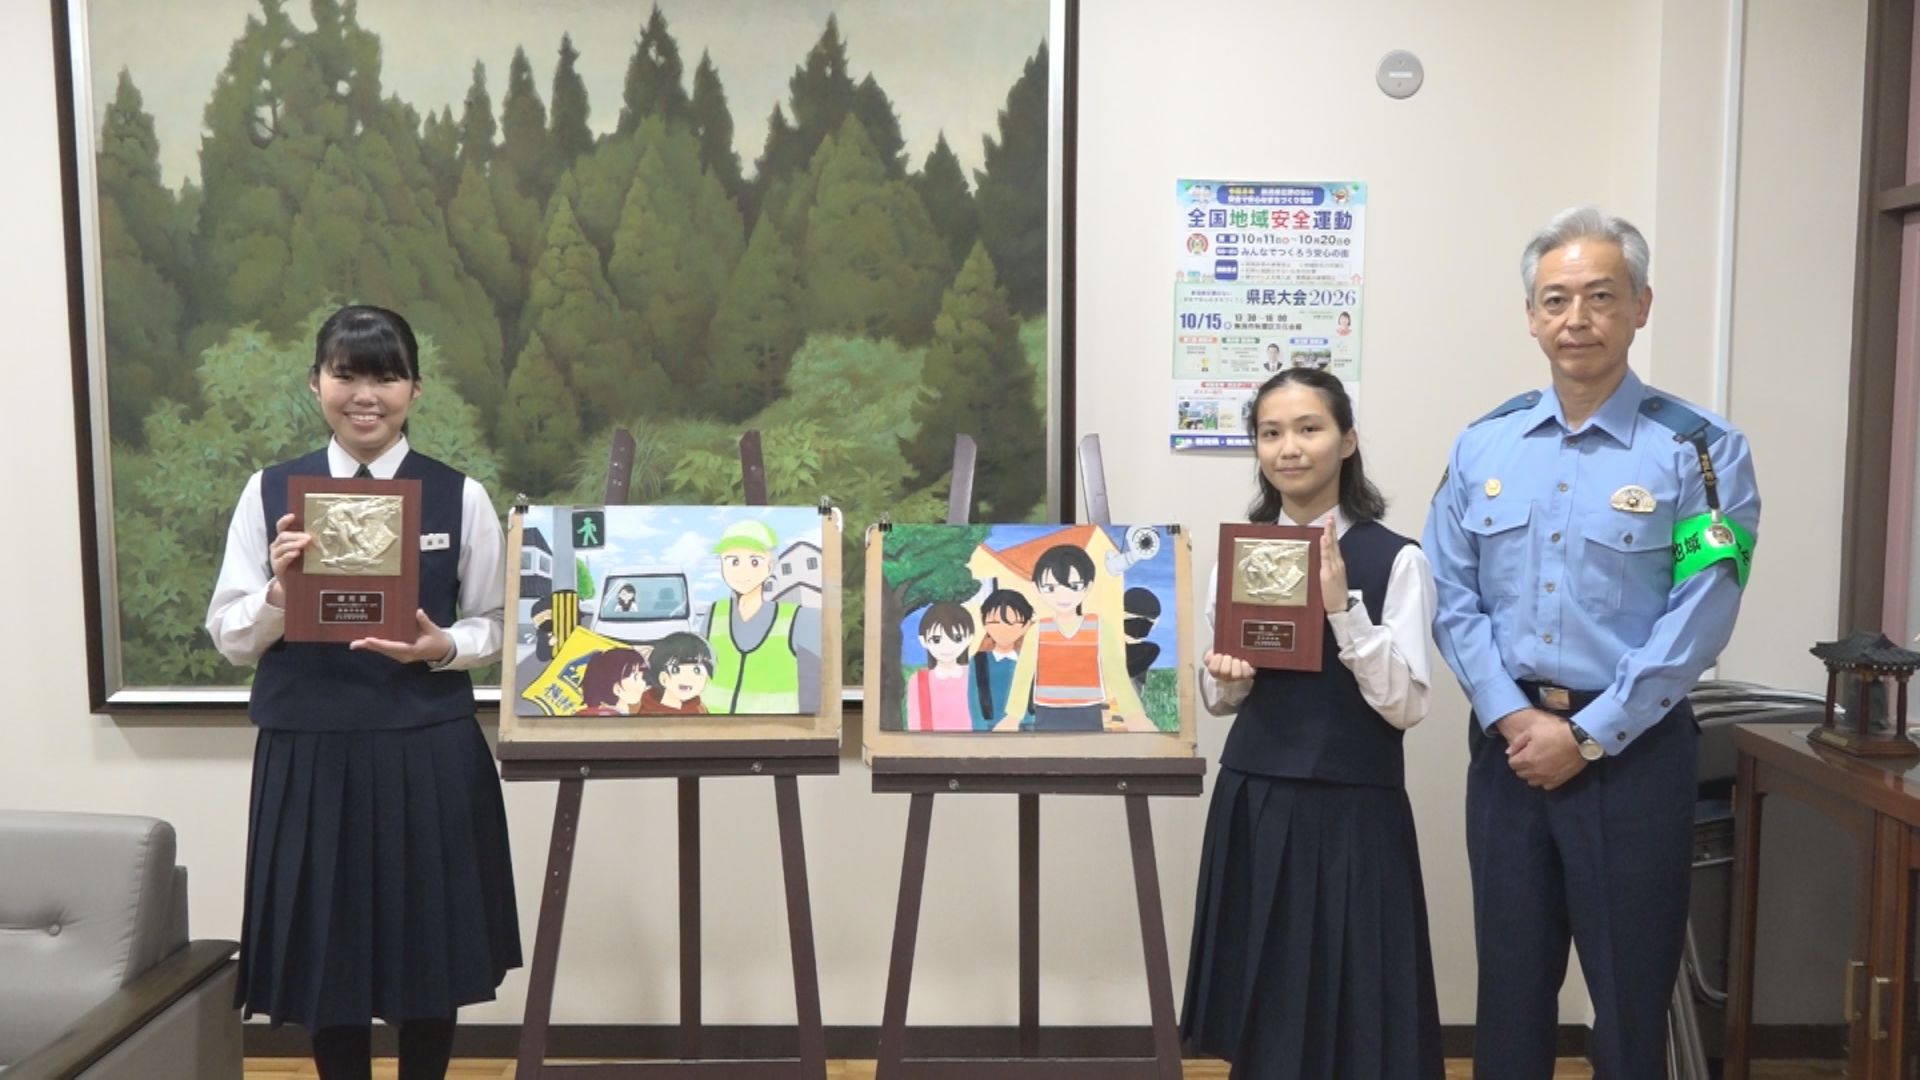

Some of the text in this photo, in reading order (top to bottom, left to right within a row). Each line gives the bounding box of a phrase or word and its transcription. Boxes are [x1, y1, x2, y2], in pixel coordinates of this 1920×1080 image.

[1188, 208, 1352, 230] 全国地域安全運動
[1179, 313, 1222, 330] 10/15
